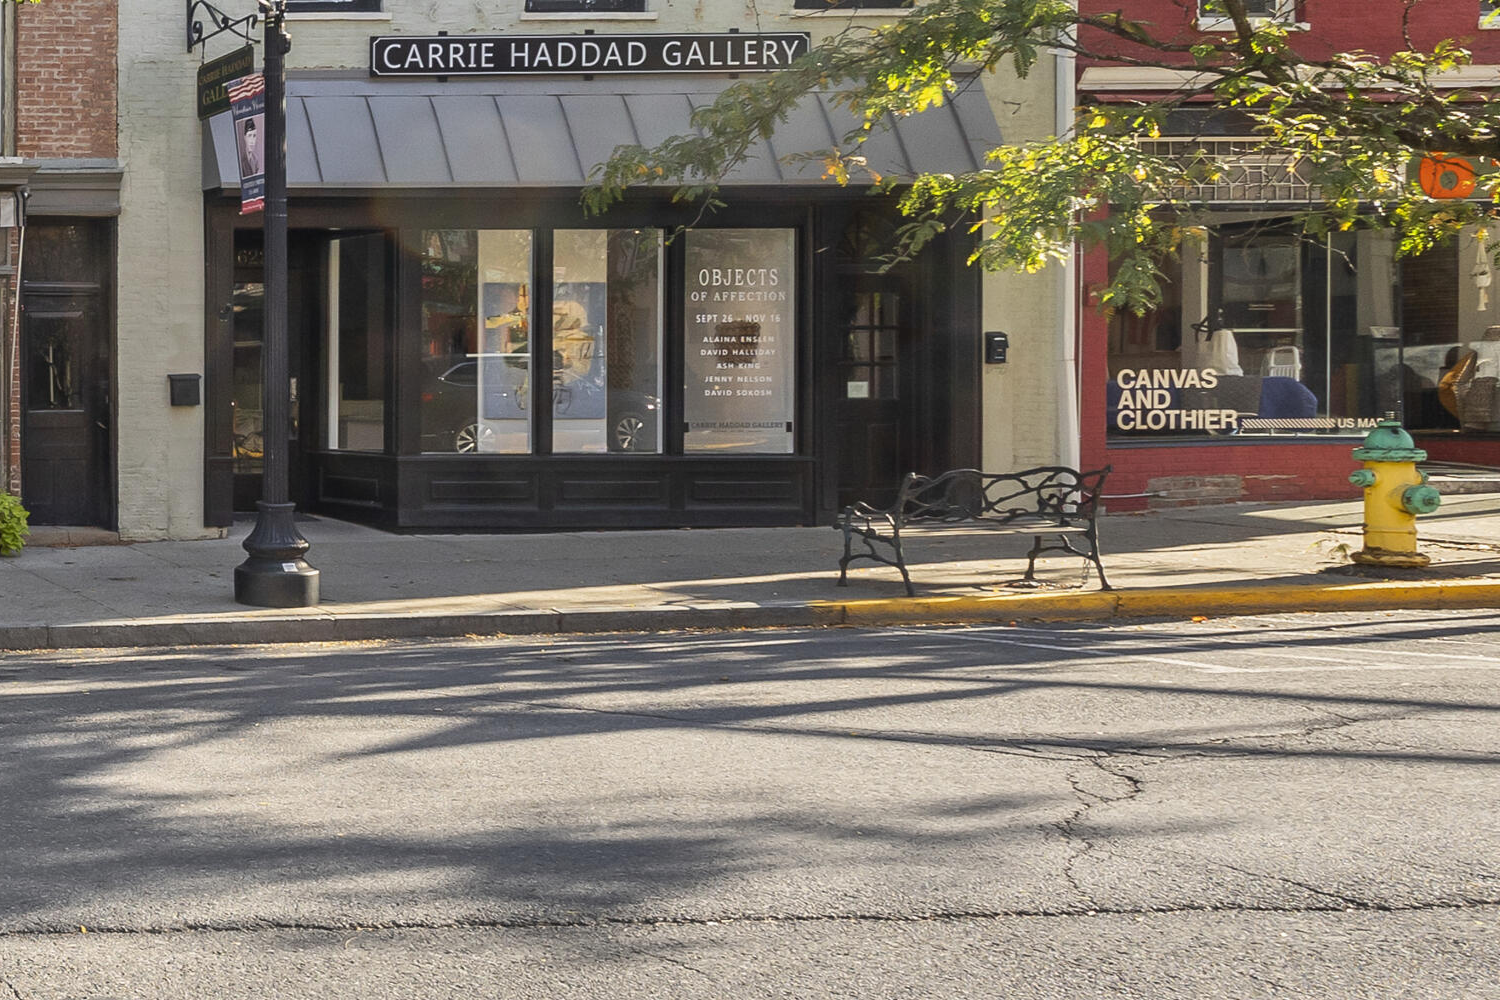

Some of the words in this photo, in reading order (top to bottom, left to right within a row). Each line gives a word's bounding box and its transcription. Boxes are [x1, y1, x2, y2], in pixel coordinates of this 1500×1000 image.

[383, 42, 495, 69] CARRIE
[510, 41, 648, 68] HADDAD
[662, 39, 799, 66] GALLERY
[699, 268, 779, 286] OBJECTS
[690, 291, 708, 302] OF
[713, 291, 787, 302] AFFECTION
[695, 314, 718, 323] SEPT
[722, 314, 733, 323] 26
[745, 314, 766, 323] NOV
[705, 375, 733, 383] JENNY
[737, 375, 773, 383] NELSON
[1117, 368, 1218, 389] CANVAS
[704, 389, 733, 397] DAVID
[1117, 389, 1171, 409] AND
[1116, 409, 1239, 431] CLOTHIER
[1337, 417, 1355, 429] US
